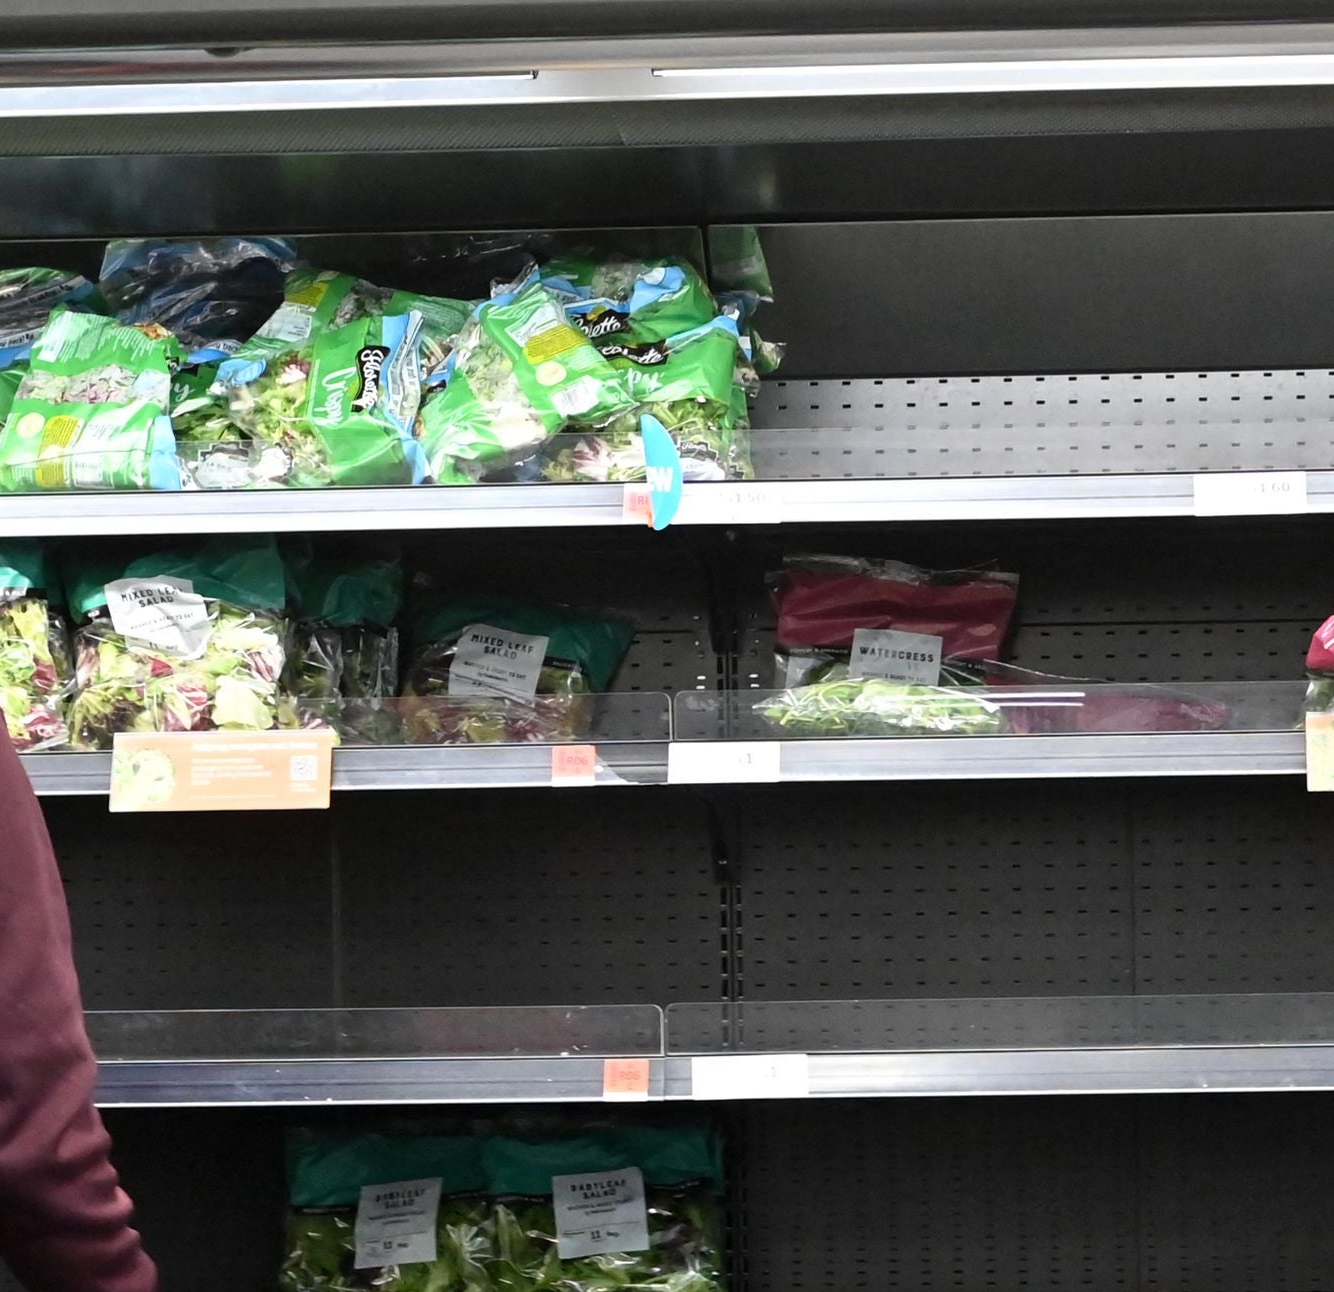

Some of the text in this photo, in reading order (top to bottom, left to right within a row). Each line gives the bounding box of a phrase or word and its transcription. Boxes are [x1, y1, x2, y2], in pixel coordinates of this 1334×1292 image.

[121, 586, 183, 602] MIXED LE
[138, 596, 174, 608] SALAD
[471, 634, 535, 654] MIXED LEAF
[483, 645, 518, 660] SALAD
[859, 646, 935, 663] WATERCRESS
[570, 1179, 627, 1192] BABYLEAF
[583, 1188, 618, 1199] SALAD
[384, 1199, 415, 1208] SALAD
